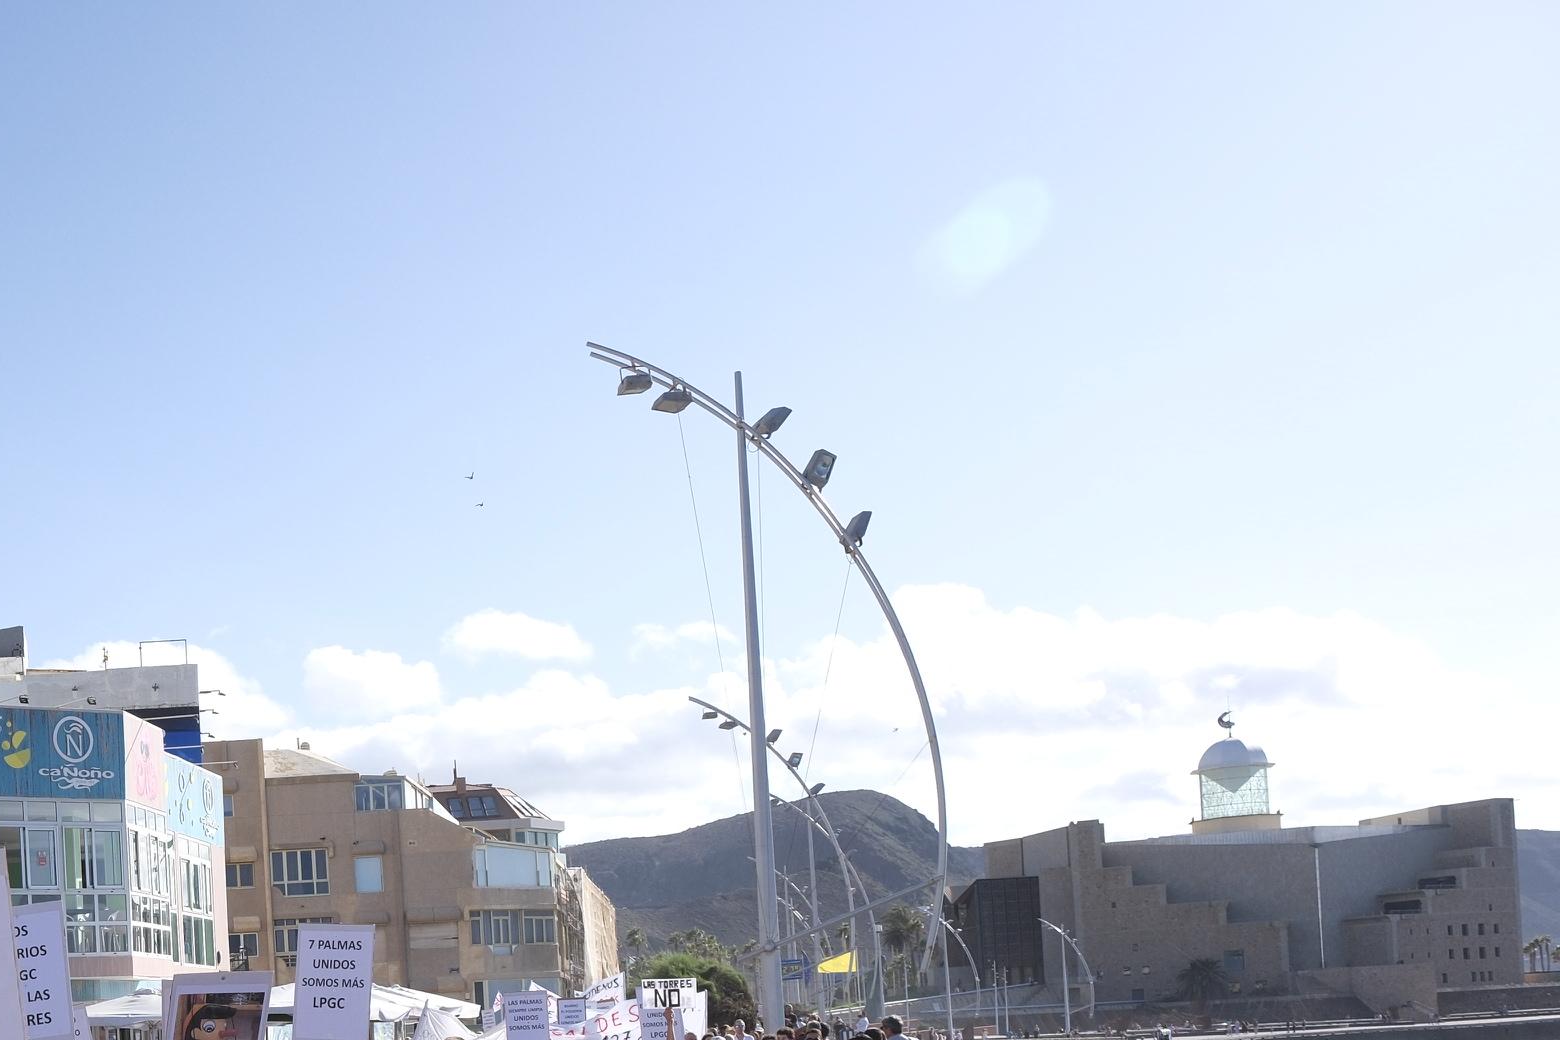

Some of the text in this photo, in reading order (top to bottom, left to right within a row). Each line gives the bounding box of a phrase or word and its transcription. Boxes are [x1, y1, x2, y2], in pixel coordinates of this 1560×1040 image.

[308, 940, 362, 950] 7 PALMAS
[17, 945, 47, 959] RIOS
[313, 959, 355, 970] UNIDOS
[20, 969, 37, 981] GC
[302, 977, 364, 988] SOMOS MÁS
[658, 979, 692, 989] TORRES
[27, 989, 50, 1002] LAS
[654, 988, 681, 1008] NO
[313, 997, 345, 1009] LPGC
[27, 1012, 52, 1026] RES
[513, 1014, 539, 1022] UNIDOS
